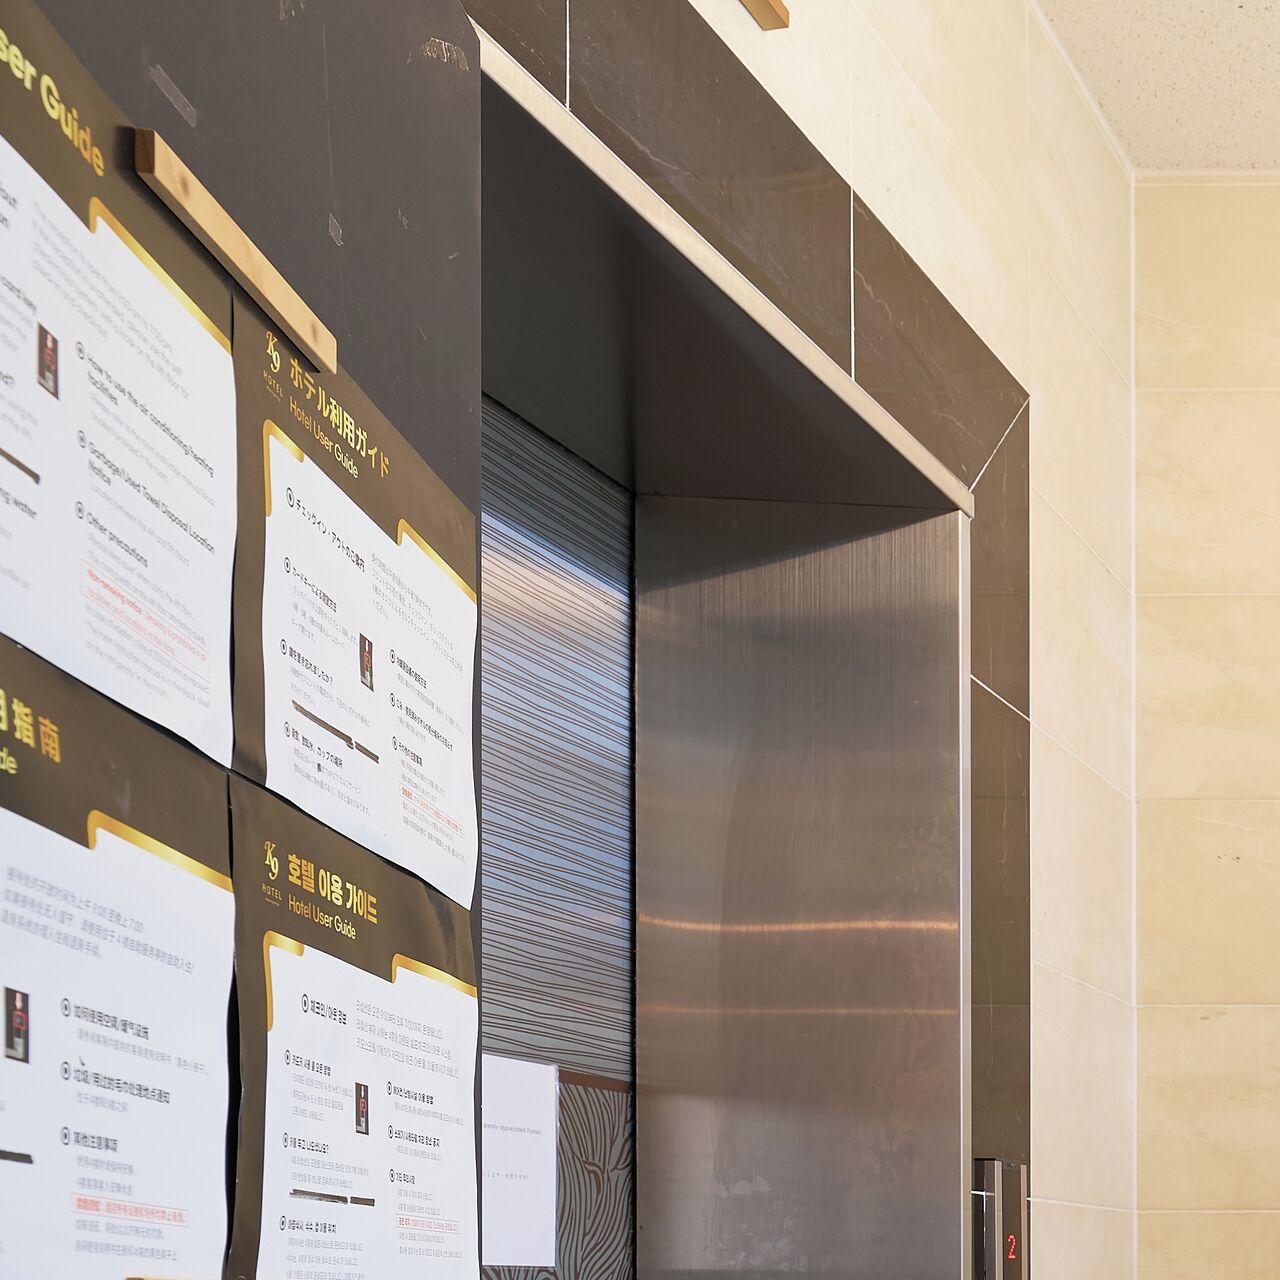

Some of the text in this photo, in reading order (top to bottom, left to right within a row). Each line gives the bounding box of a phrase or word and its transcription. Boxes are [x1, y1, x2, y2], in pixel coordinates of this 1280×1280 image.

[0, 27, 105, 177] ser Guide
[263, 370, 284, 398] HOTEL
[289, 357, 390, 478] ホテル利用ガイド
[289, 396, 359, 479] Hotel User Guide
[261, 883, 282, 901] HOTEL
[288, 854, 378, 925] 호텔 이용 가이드
[288, 893, 356, 940] Hotel User Guide
[1008, 1234, 1016, 1260] 2
